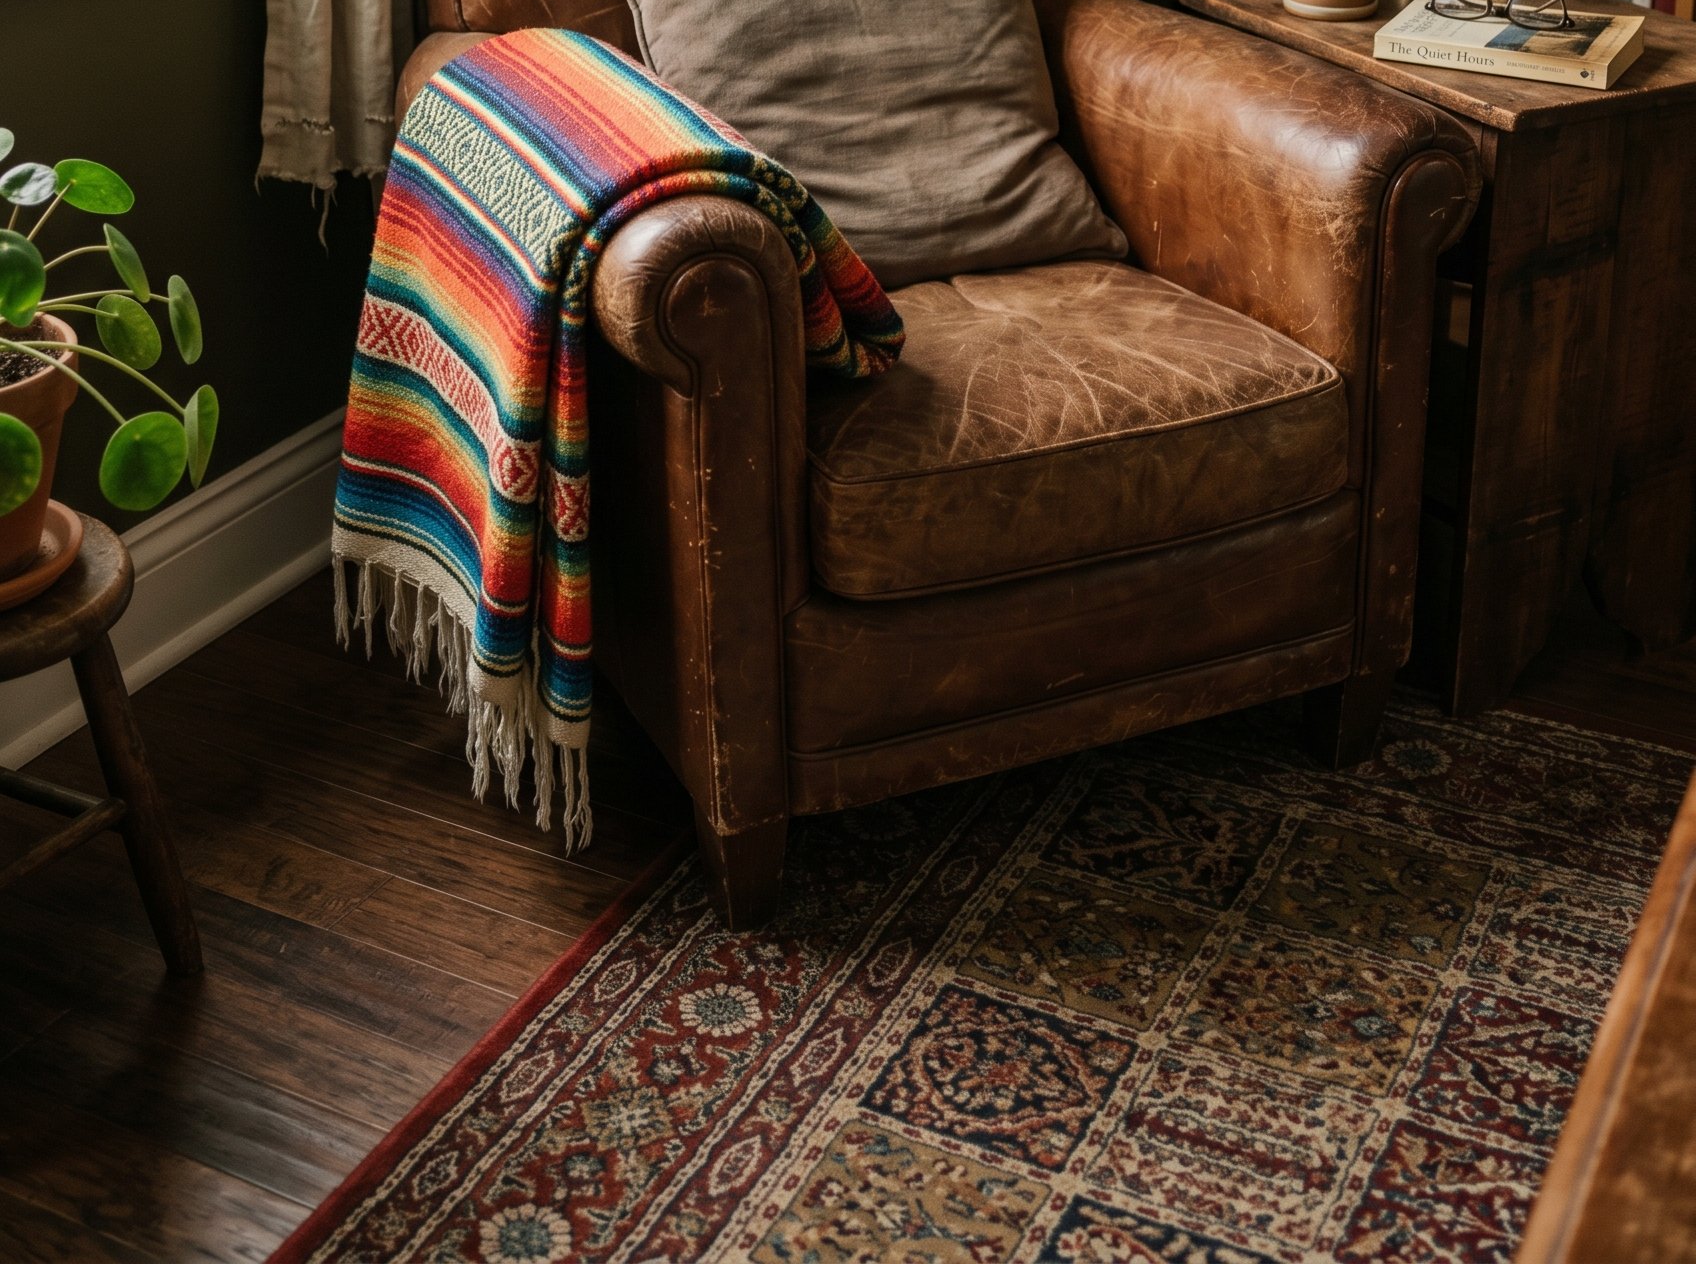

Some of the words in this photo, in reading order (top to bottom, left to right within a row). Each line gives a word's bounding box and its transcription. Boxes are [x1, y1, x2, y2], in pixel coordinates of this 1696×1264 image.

[1389, 42, 1412, 55] The
[1417, 46, 1452, 60] Quiet
[1457, 51, 1495, 66] Hours
